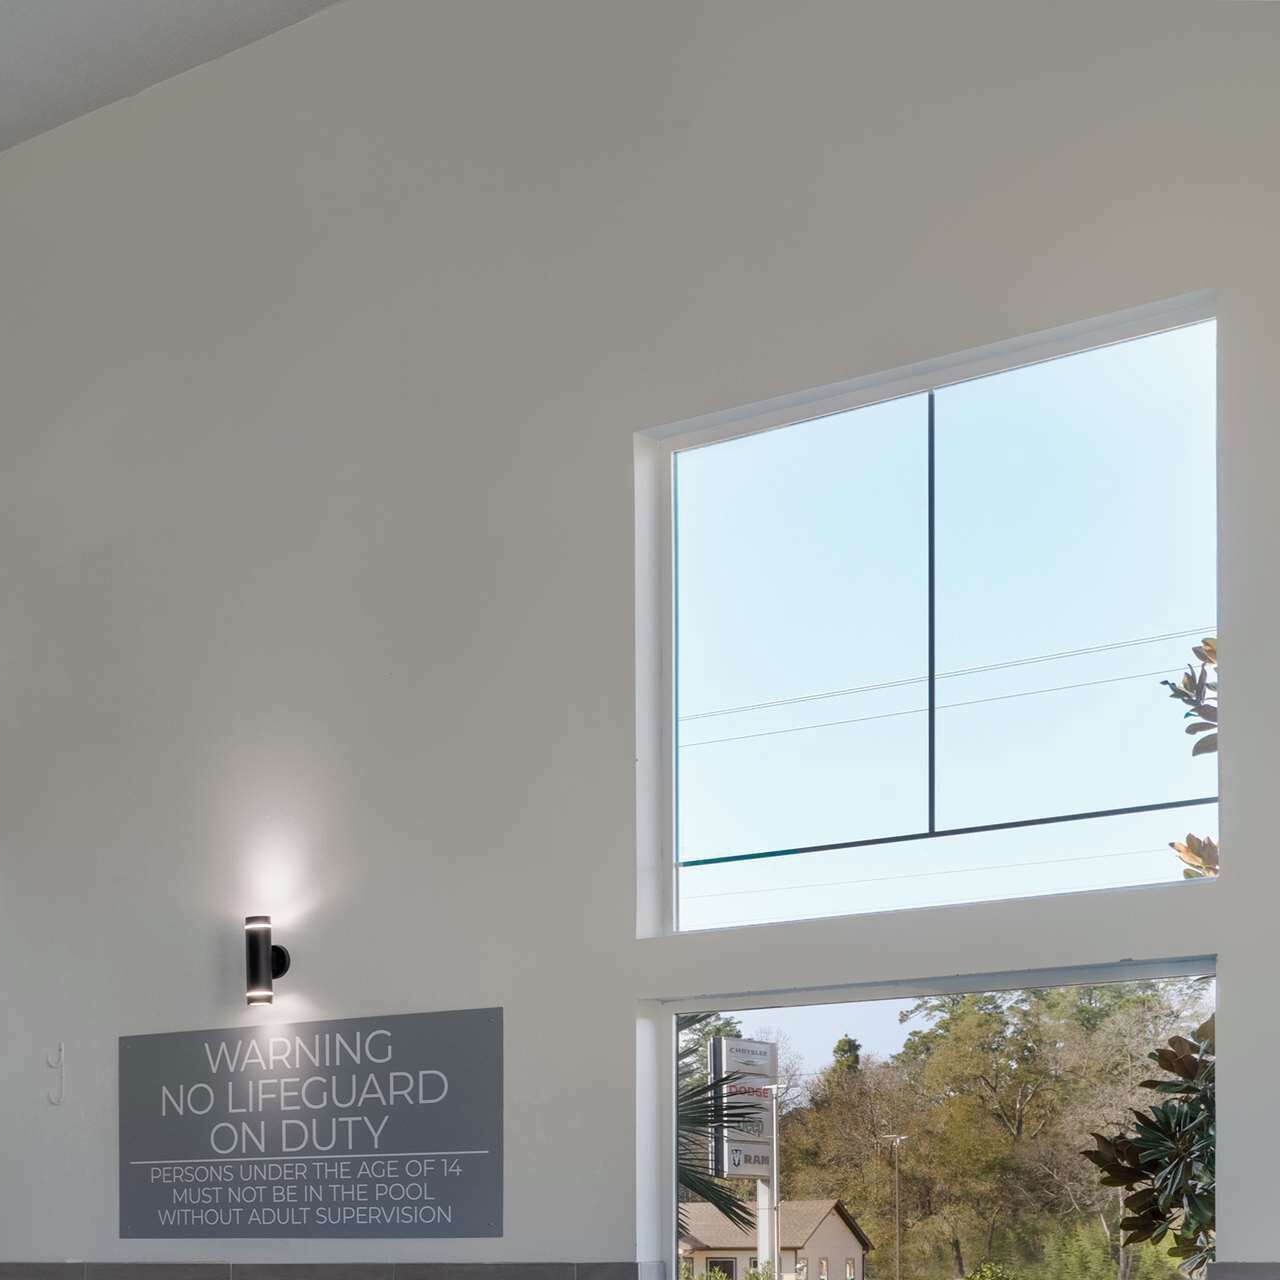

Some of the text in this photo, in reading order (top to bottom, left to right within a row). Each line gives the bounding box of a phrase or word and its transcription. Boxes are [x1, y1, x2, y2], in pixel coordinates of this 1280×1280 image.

[204, 1030, 393, 1073] WARNING
[729, 1047, 768, 1057] CHRYSLER
[161, 1070, 449, 1116] NO LIFEGUARD
[726, 1085, 769, 1098] DODGE
[210, 1115, 390, 1154] ON DUTY
[151, 1158, 463, 1183] PERSONS UNDER THE AGE OF 14
[743, 1154, 770, 1165] RAM
[172, 1182, 436, 1205] MUST NOT BE IN THE POOL
[157, 1205, 453, 1225] WITHOUT ADULT SUPERVISION
